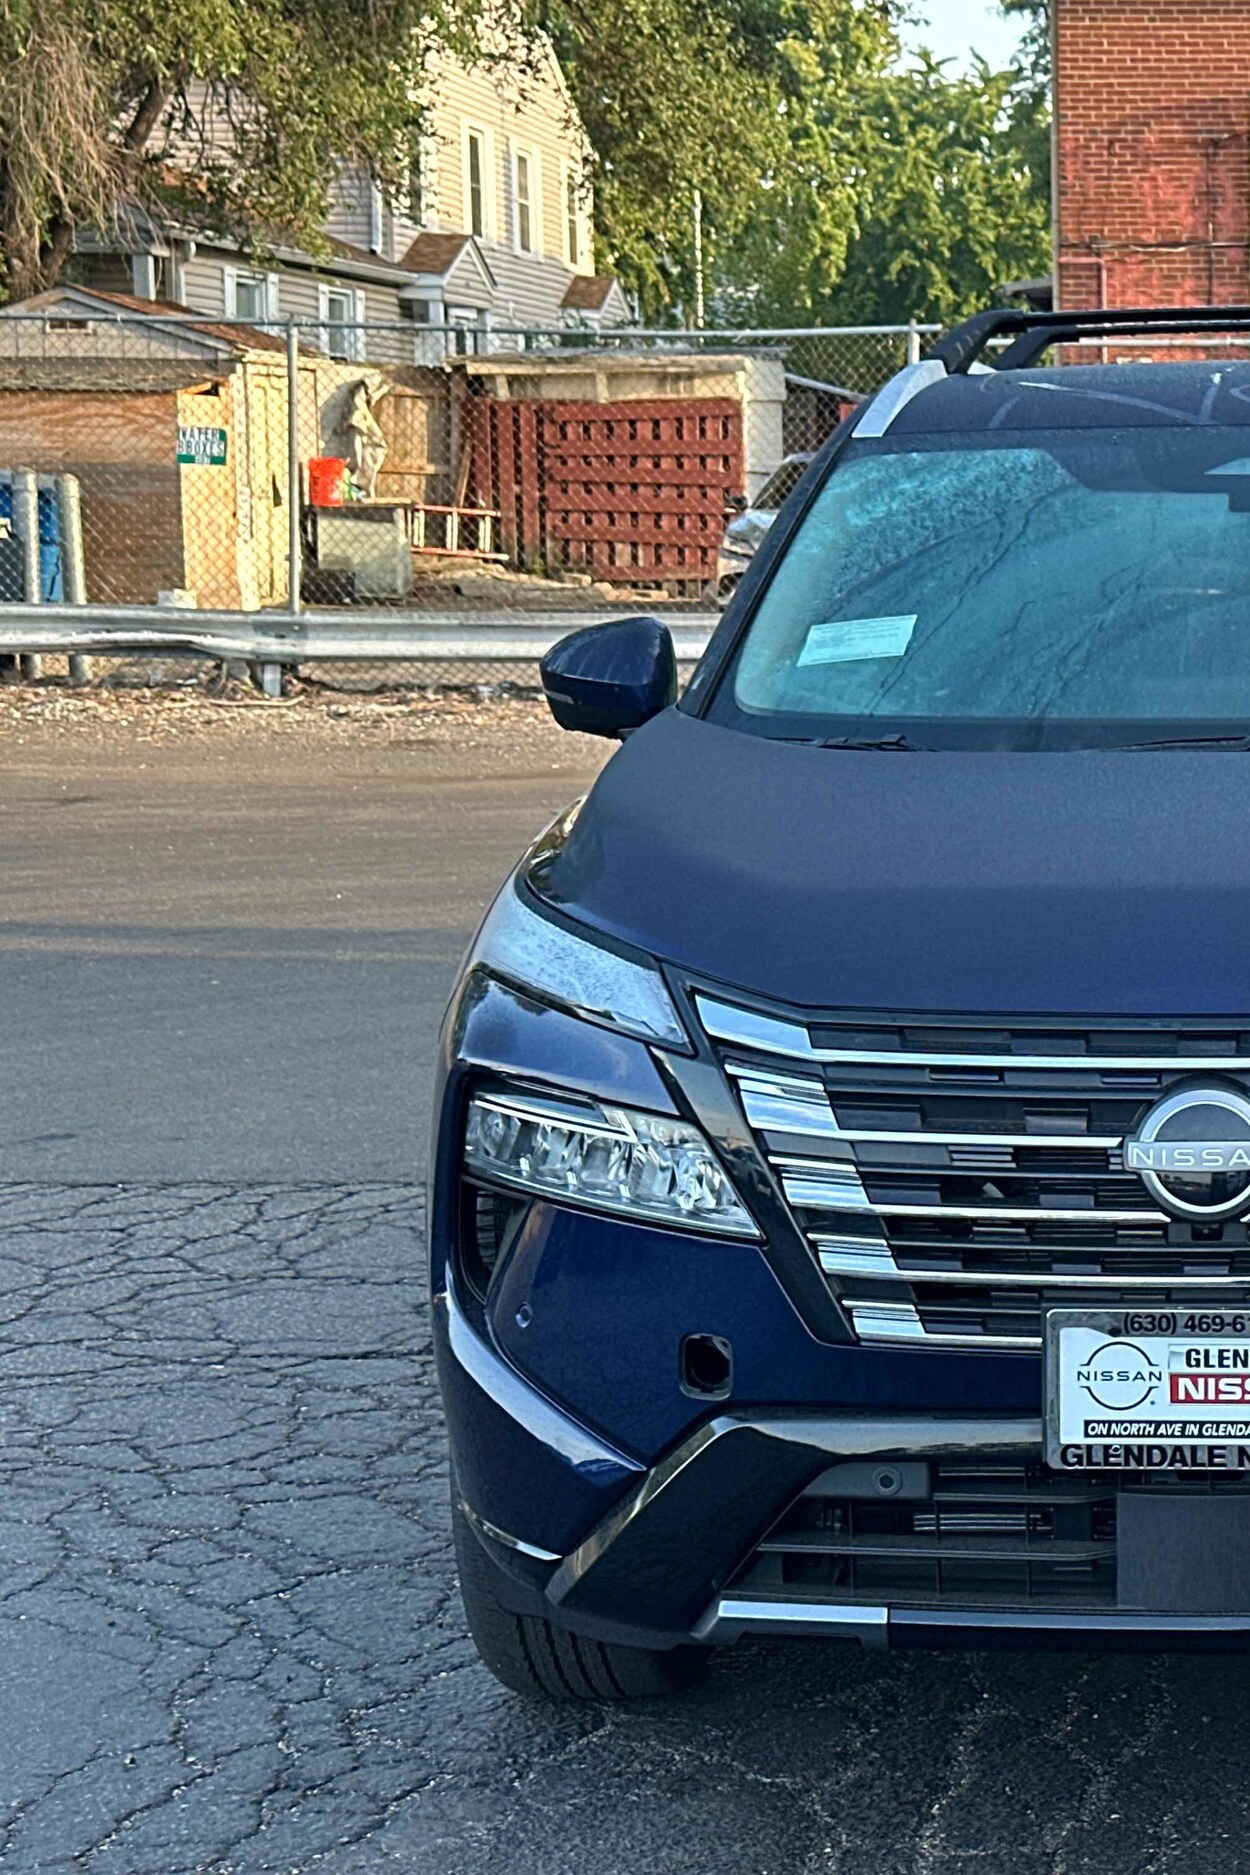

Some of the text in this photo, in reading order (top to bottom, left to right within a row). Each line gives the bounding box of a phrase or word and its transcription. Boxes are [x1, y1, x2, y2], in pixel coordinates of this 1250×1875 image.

[1123, 1312, 1177, 1336] (630)
[1077, 1370, 1162, 1382] NISSAN
[1087, 1422, 1109, 1436] ON
[1110, 1423, 1155, 1437] NORTH
[1157, 1423, 1183, 1437] AVE
[1185, 1423, 1199, 1437] IN
[1060, 1443, 1228, 1469] GLENDALE
